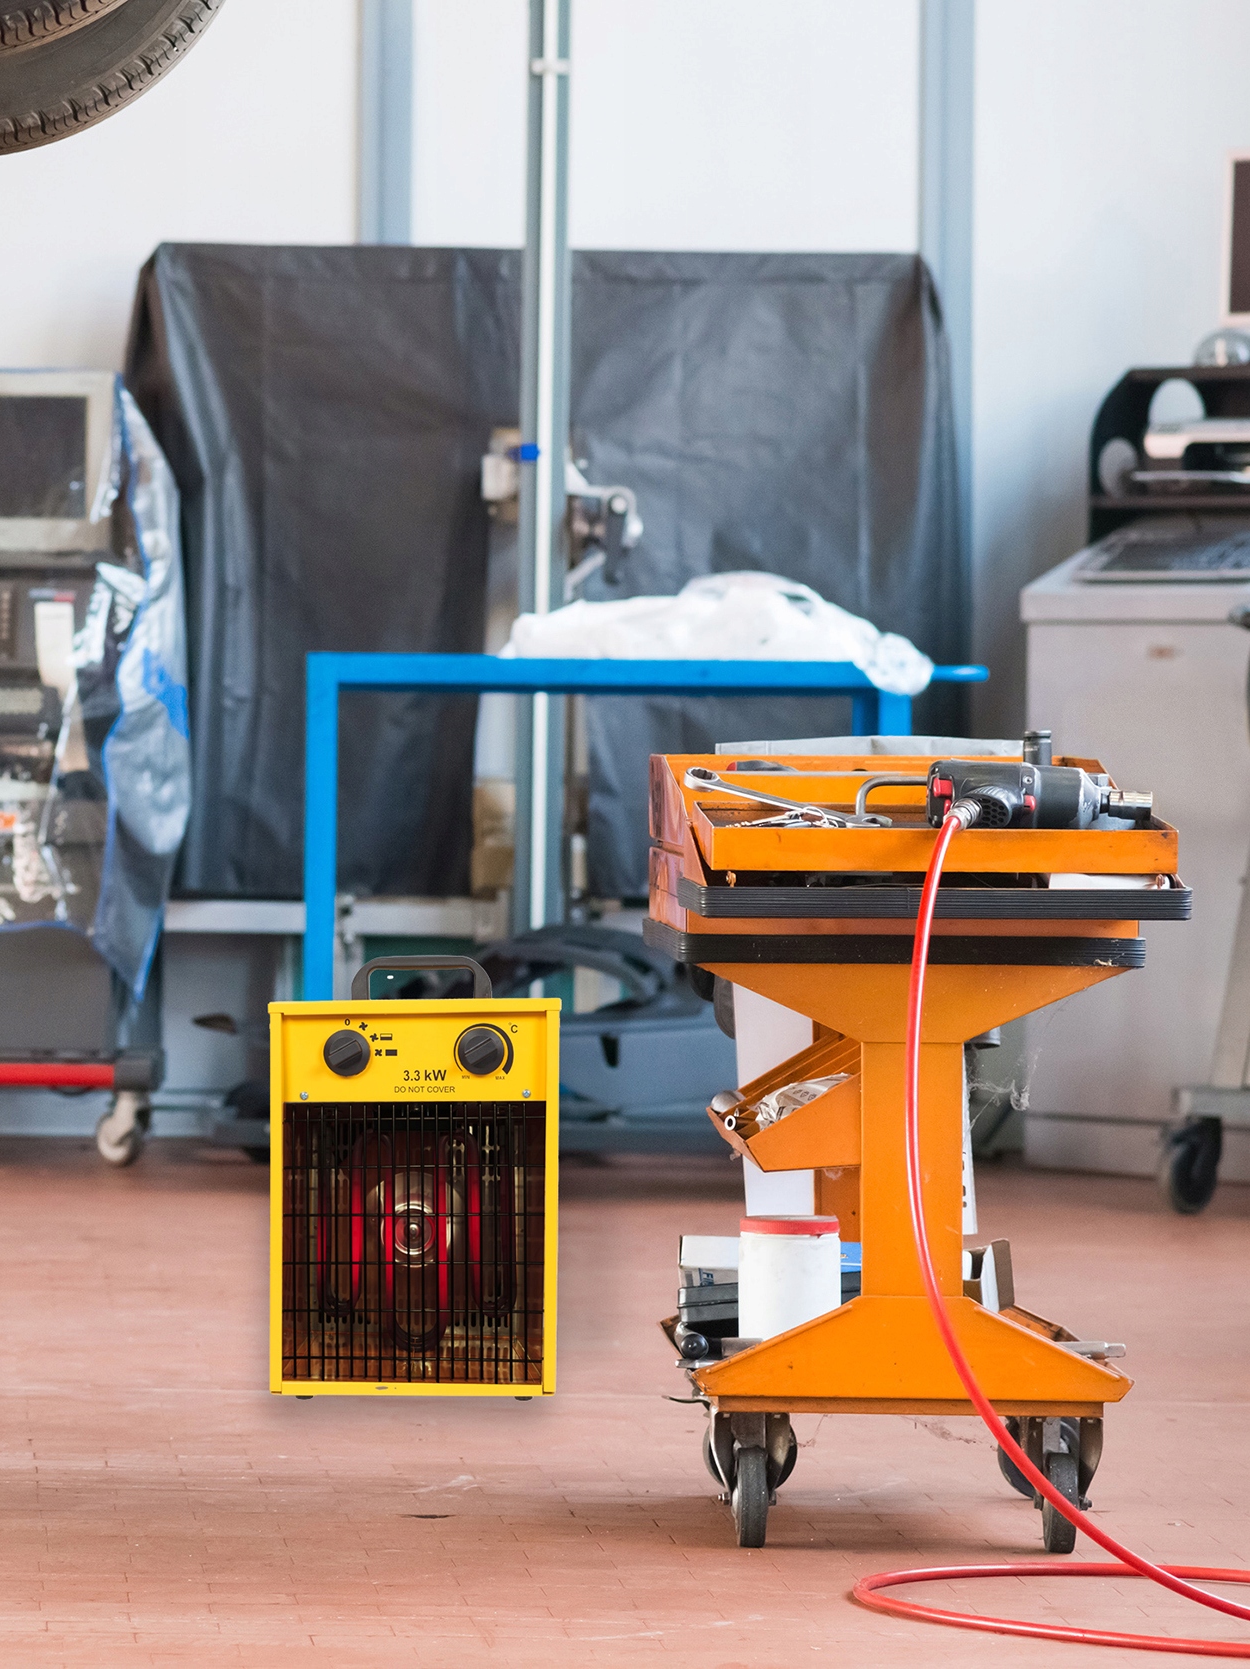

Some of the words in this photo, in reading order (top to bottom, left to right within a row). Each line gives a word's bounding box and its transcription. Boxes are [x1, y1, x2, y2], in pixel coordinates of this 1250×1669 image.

[403, 1069, 421, 1081] 3.3
[424, 1069, 447, 1081] kW
[394, 1085, 407, 1094] DO
[408, 1085, 425, 1094] NOT
[427, 1085, 456, 1094] COVER
